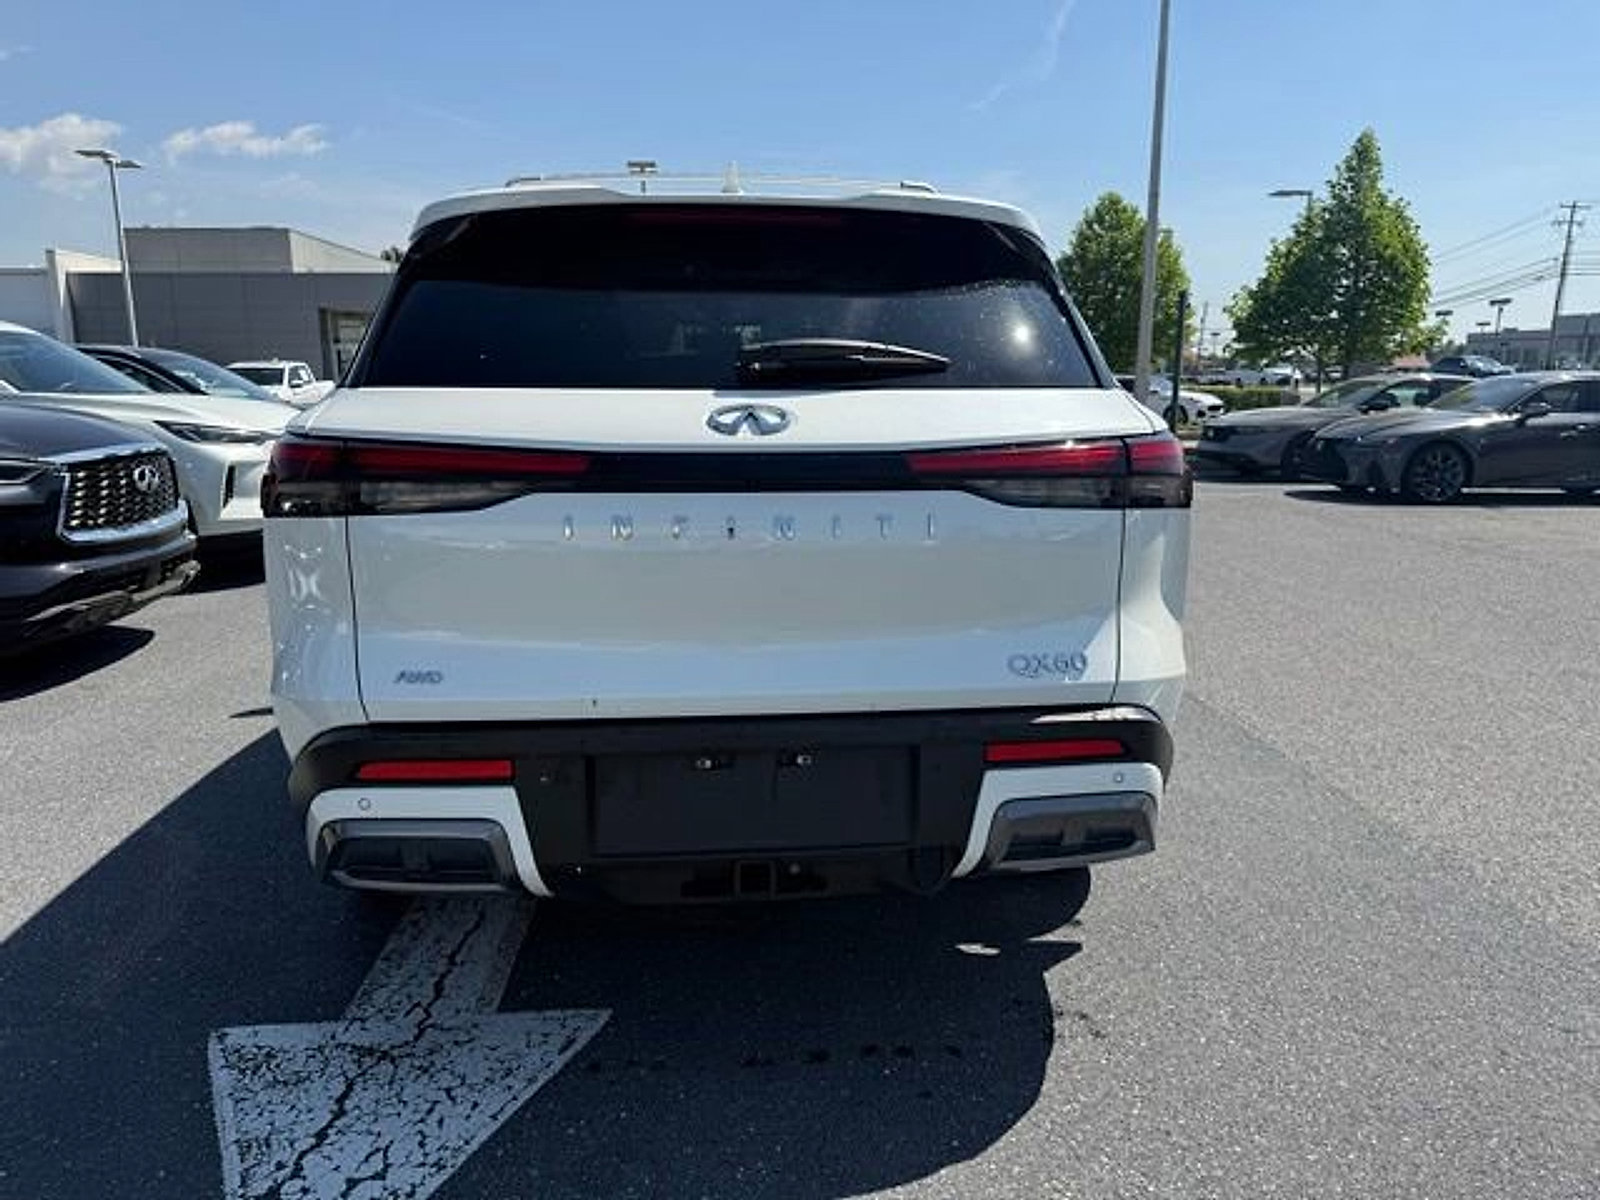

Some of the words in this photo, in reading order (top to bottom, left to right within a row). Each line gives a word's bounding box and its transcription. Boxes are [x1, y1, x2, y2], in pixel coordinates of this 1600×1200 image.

[563, 513, 938, 541] INFINITI
[393, 670, 443, 684] AWD
[1007, 653, 1087, 679] QX60
